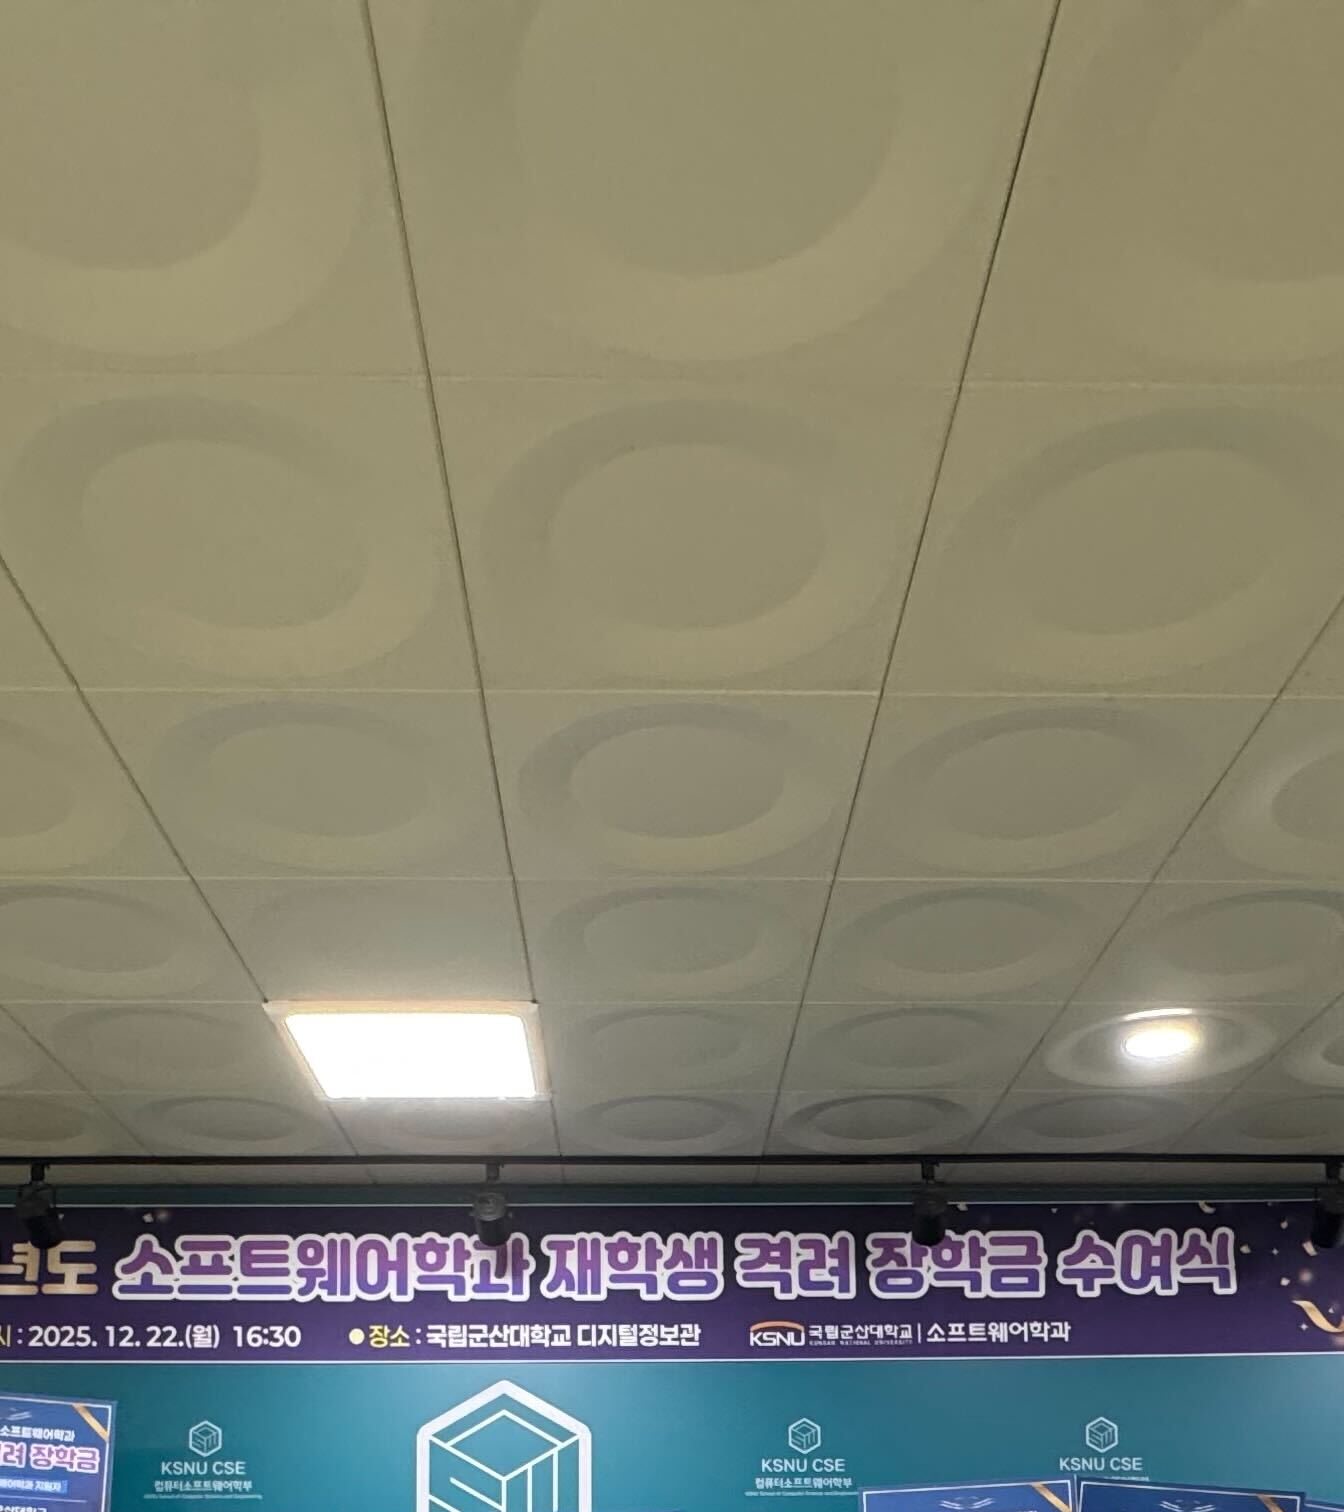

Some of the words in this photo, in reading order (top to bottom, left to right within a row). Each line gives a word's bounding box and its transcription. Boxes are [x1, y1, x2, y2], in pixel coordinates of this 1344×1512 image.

[112, 1233, 535, 1302] 소프트웨어학과
[540, 1230, 724, 1301] 재학생
[734, 1230, 856, 1300] 격려
[866, 1229, 1047, 1299] 장학금
[1056, 1227, 1239, 1297] 수여식
[28, 1325, 98, 1348] 2025.
[105, 1325, 141, 1348] 12.
[146, 1324, 220, 1350] 22.(월)
[233, 1325, 302, 1348] 16:30
[369, 1324, 411, 1349] 장소
[426, 1322, 572, 1349] 국립군산대학교
[577, 1322, 702, 1348] 디지털정보관
[750, 1330, 805, 1348] KSNU
[809, 1324, 913, 1340] 국립군산대학교
[926, 1320, 1072, 1343] 소프트웨어학과
[30, 1444, 101, 1474] 장학금
[161, 1461, 207, 1475] KSNU
[212, 1461, 246, 1475] CSE
[761, 1458, 807, 1472] KSNU
[812, 1458, 846, 1472] CSE
[1059, 1456, 1105, 1471] KSNU
[1109, 1456, 1144, 1471] CSE
